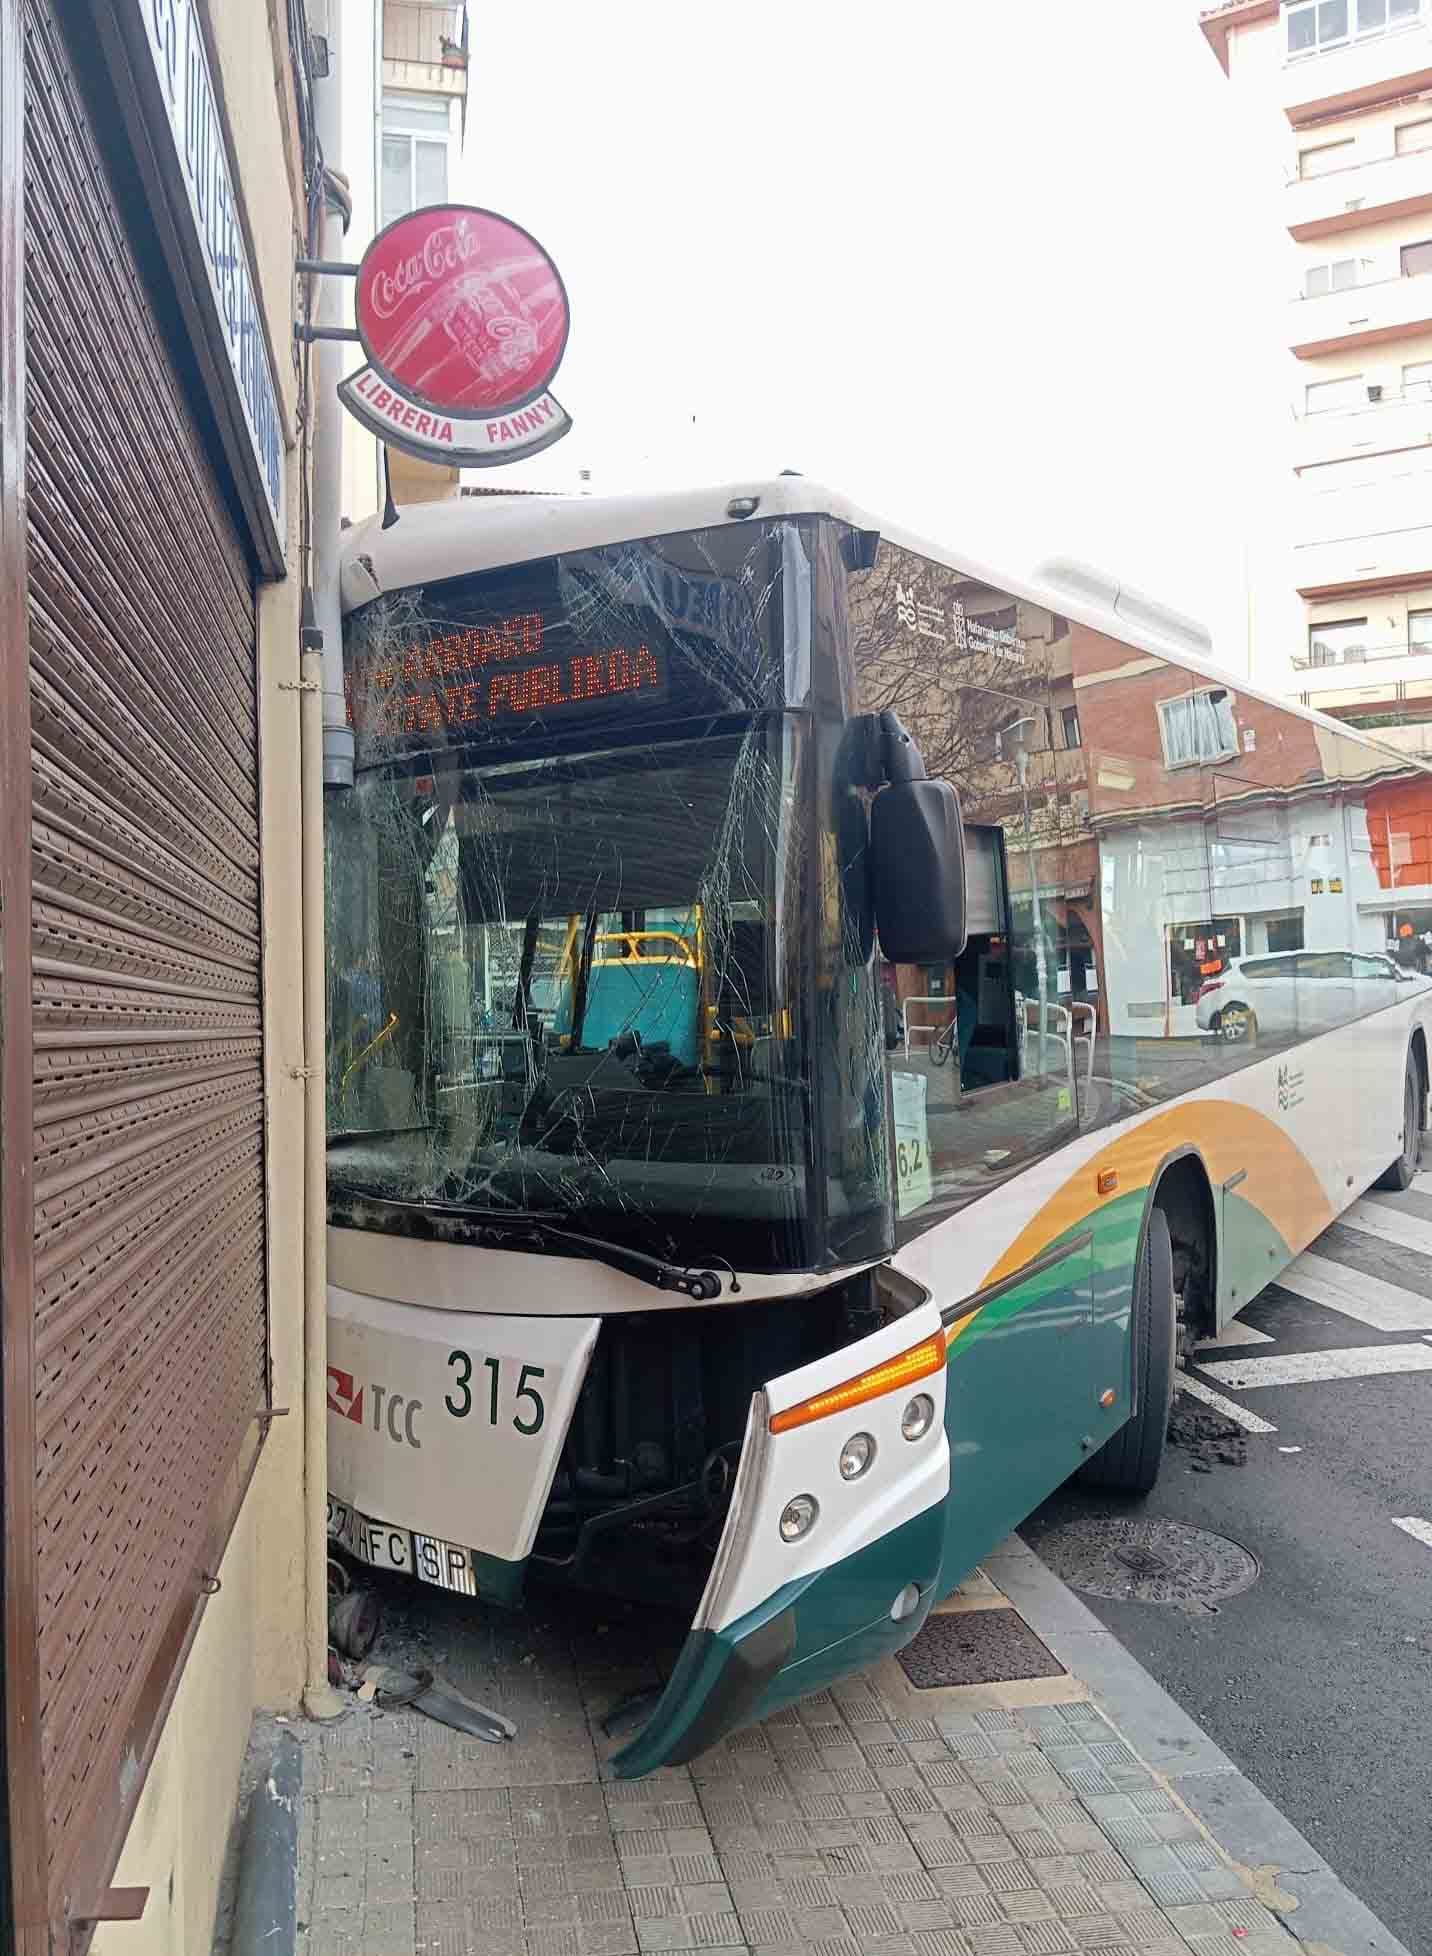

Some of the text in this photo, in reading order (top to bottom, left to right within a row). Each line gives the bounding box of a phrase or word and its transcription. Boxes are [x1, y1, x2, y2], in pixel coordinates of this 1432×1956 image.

[184, 5, 239, 346] DULCES
[370, 218, 480, 318] Coca-Cola
[355, 374, 556, 443] LIBRERIA FANNY
[487, 643, 658, 721] PUBLIKOA
[897, 1138, 923, 1178] 6.2
[371, 1383, 423, 1449] TCC
[444, 1349, 545, 1436] 315
[421, 1543, 467, 1584] SP
